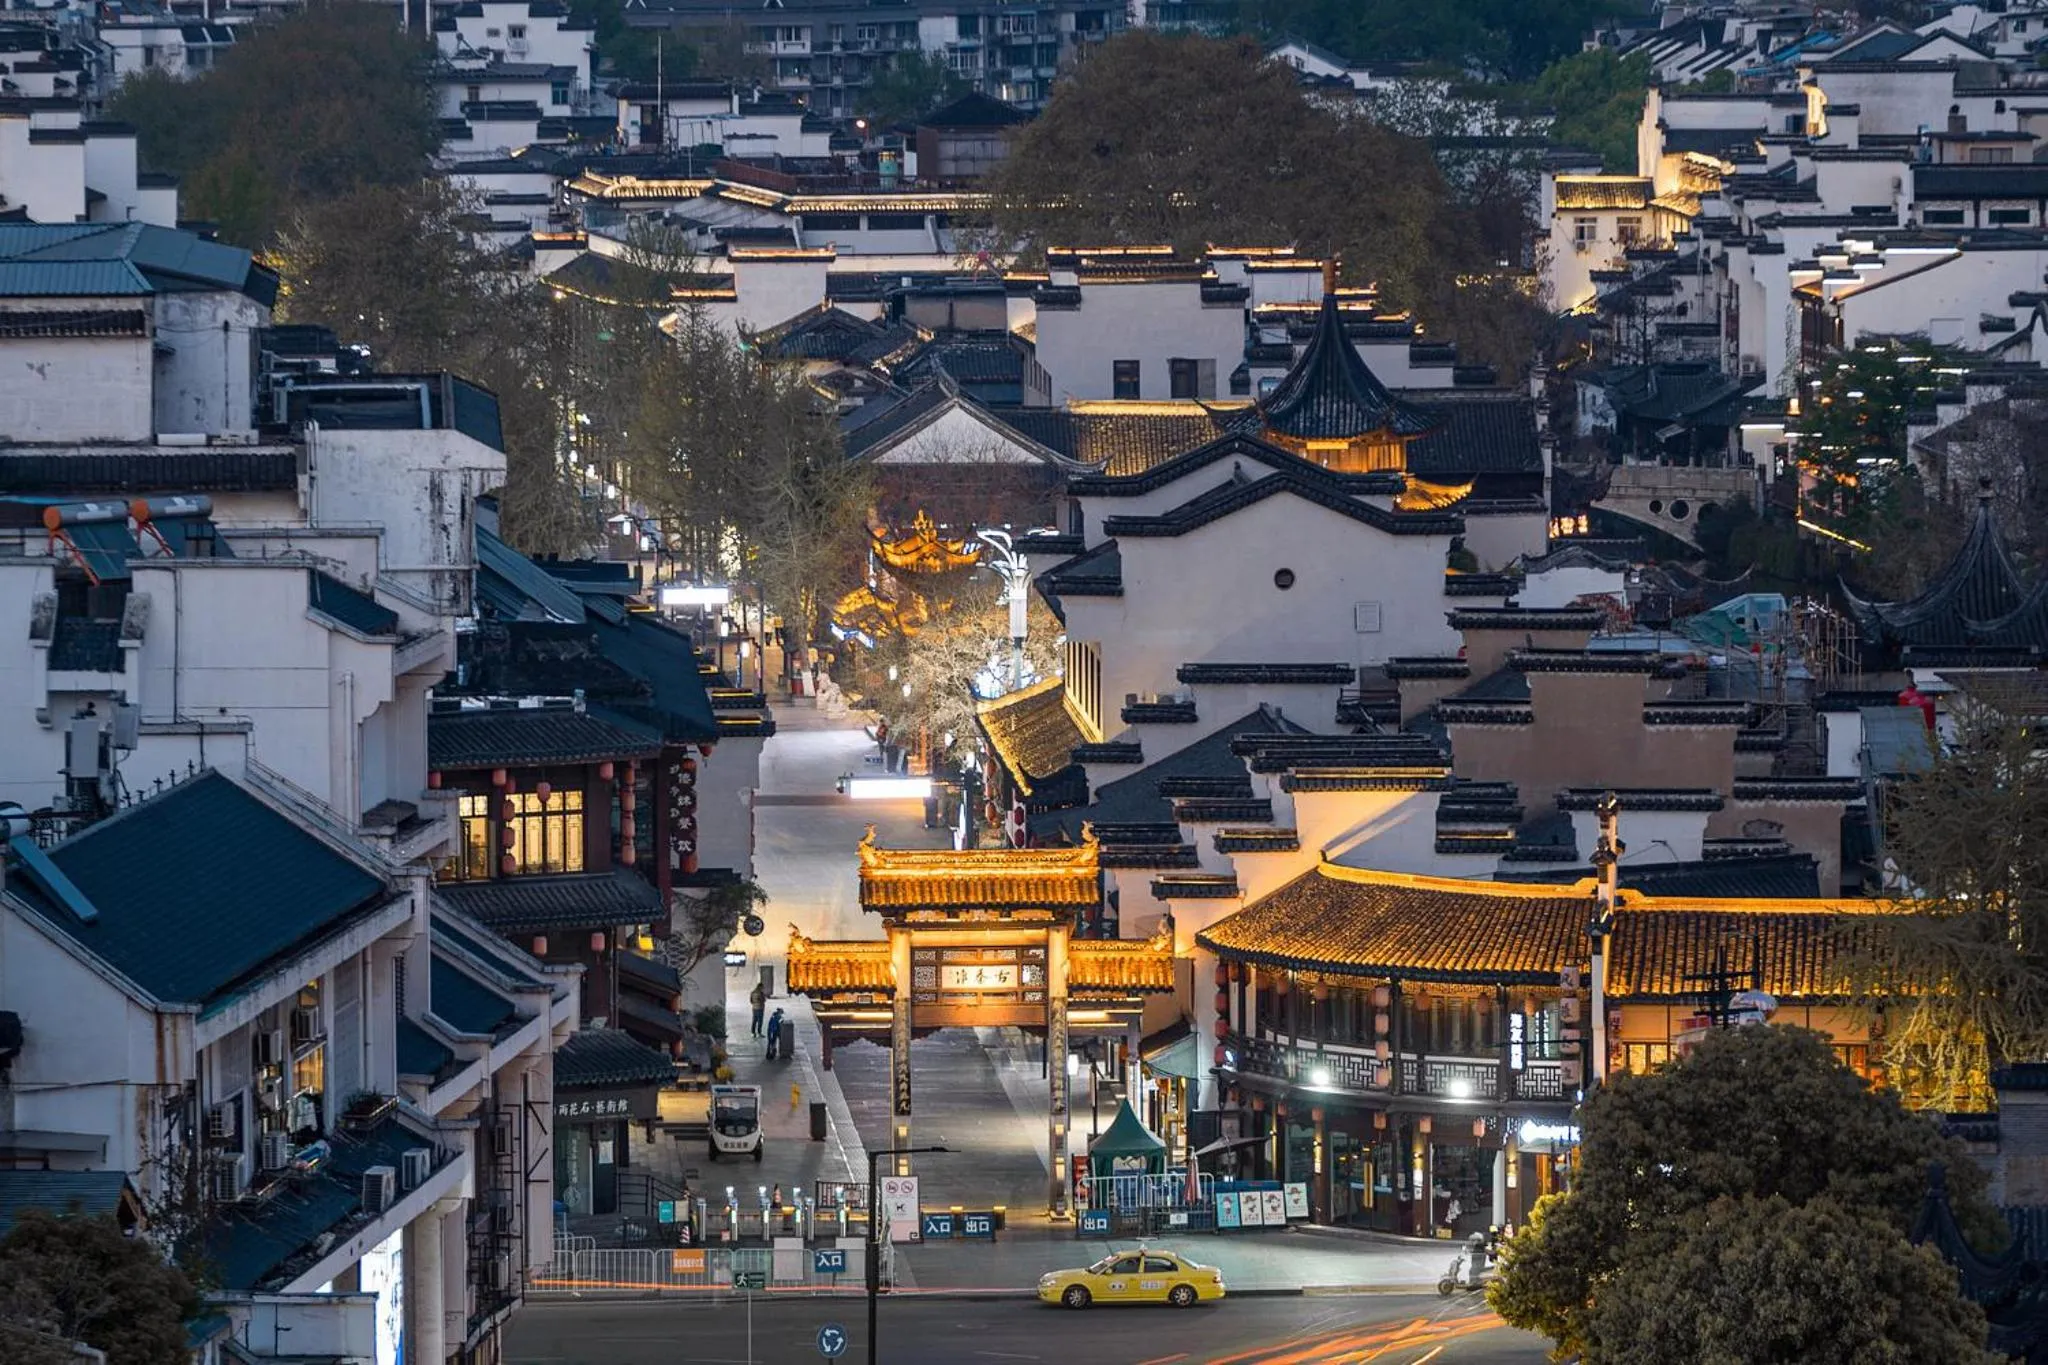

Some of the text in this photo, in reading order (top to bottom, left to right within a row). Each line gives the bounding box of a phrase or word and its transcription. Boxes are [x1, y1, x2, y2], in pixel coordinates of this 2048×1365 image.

[926, 1221, 951, 1233] 入口
[966, 1220, 990, 1232] 出口
[1084, 1218, 1107, 1230] 出口
[818, 1254, 842, 1266] 入口
